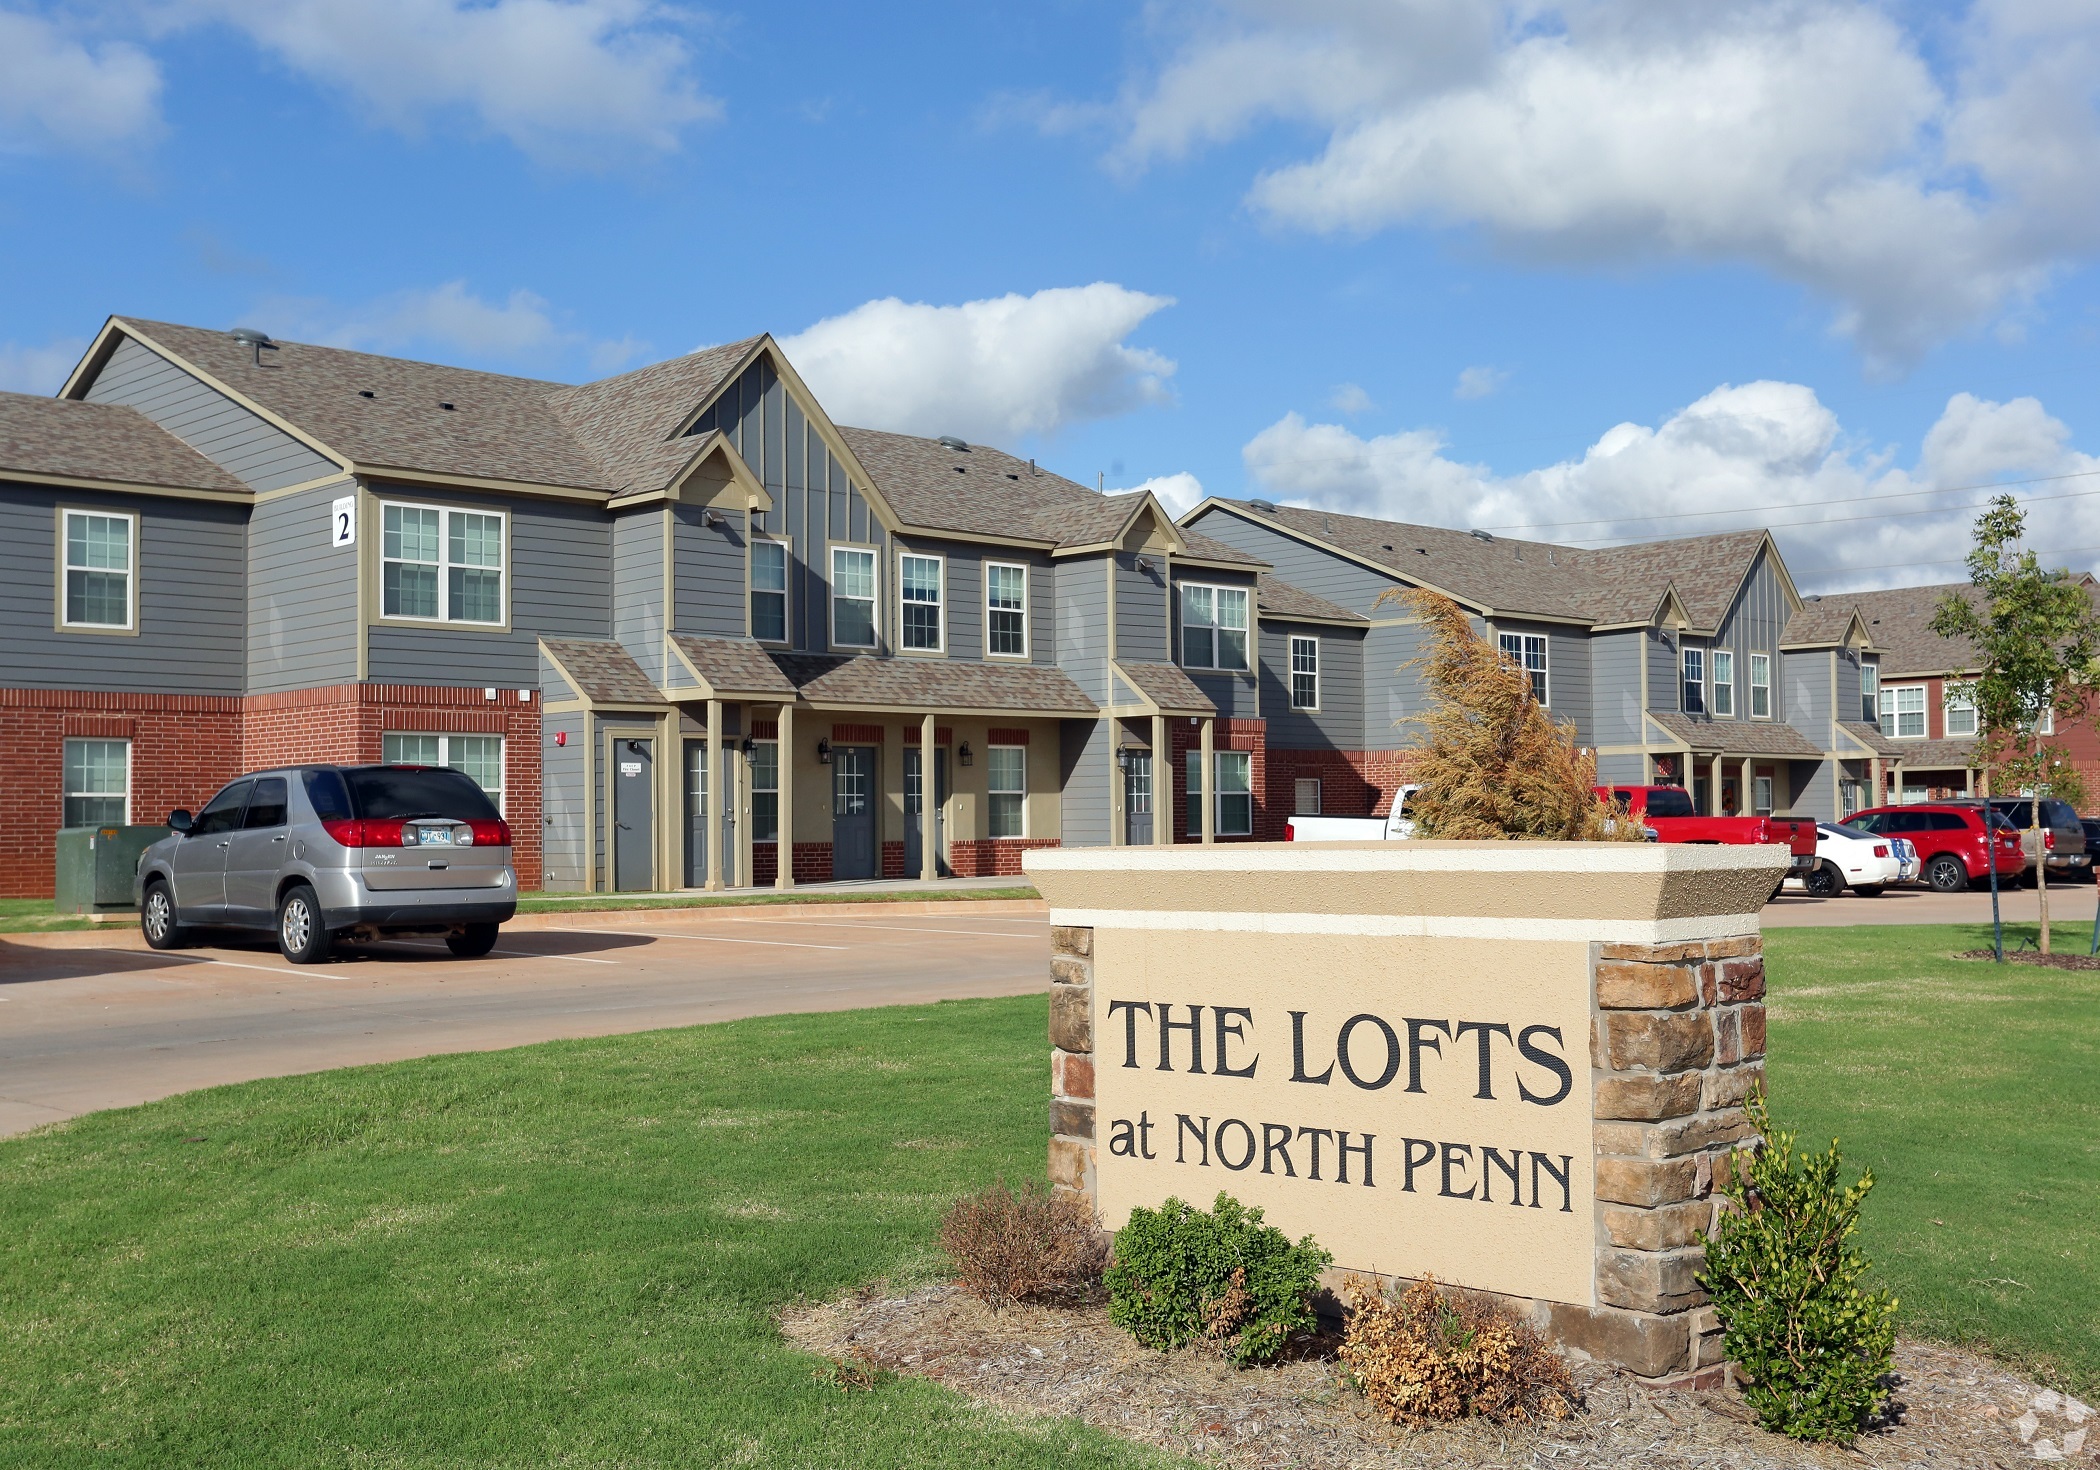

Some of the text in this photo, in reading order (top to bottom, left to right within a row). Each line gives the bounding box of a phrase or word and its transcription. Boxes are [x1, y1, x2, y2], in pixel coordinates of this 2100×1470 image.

[338, 512, 350, 541] 2
[1108, 1000, 1573, 1106] THE LOFTS
[1110, 1111, 1573, 1212] at NORTH PENN
